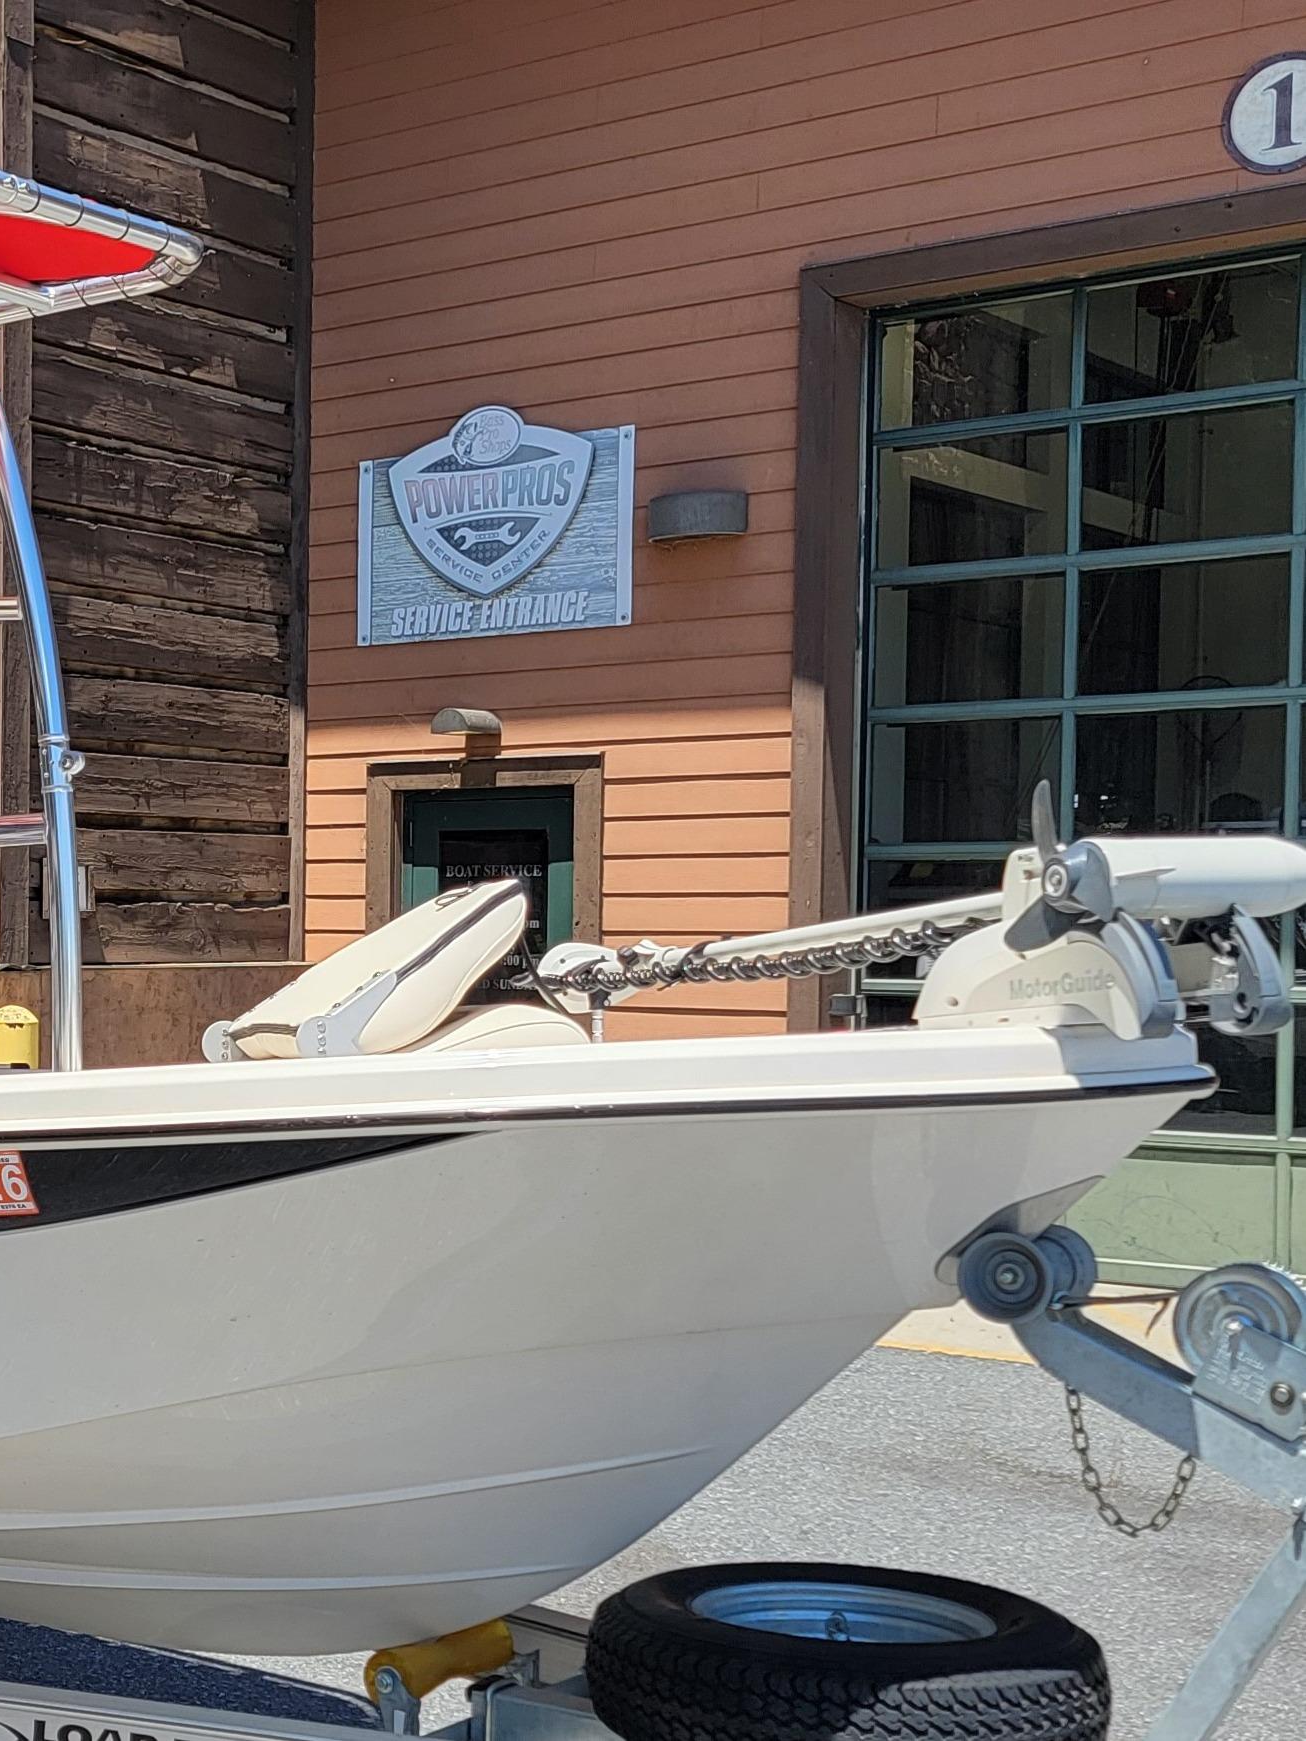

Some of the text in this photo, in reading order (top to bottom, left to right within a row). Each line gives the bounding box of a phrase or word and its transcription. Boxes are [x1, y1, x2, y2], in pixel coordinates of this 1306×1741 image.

[1260, 72, 1302, 152] 1
[403, 460, 575, 524] POWERPROS
[426, 529, 551, 584] SERVICE CENTER
[390, 590, 590, 638] SERVICE ENTRANCE
[446, 864, 543, 878] BOAT SERVICE
[1009, 969, 1115, 1001] MotorGuide
[33, 1719, 159, 1741] LO
